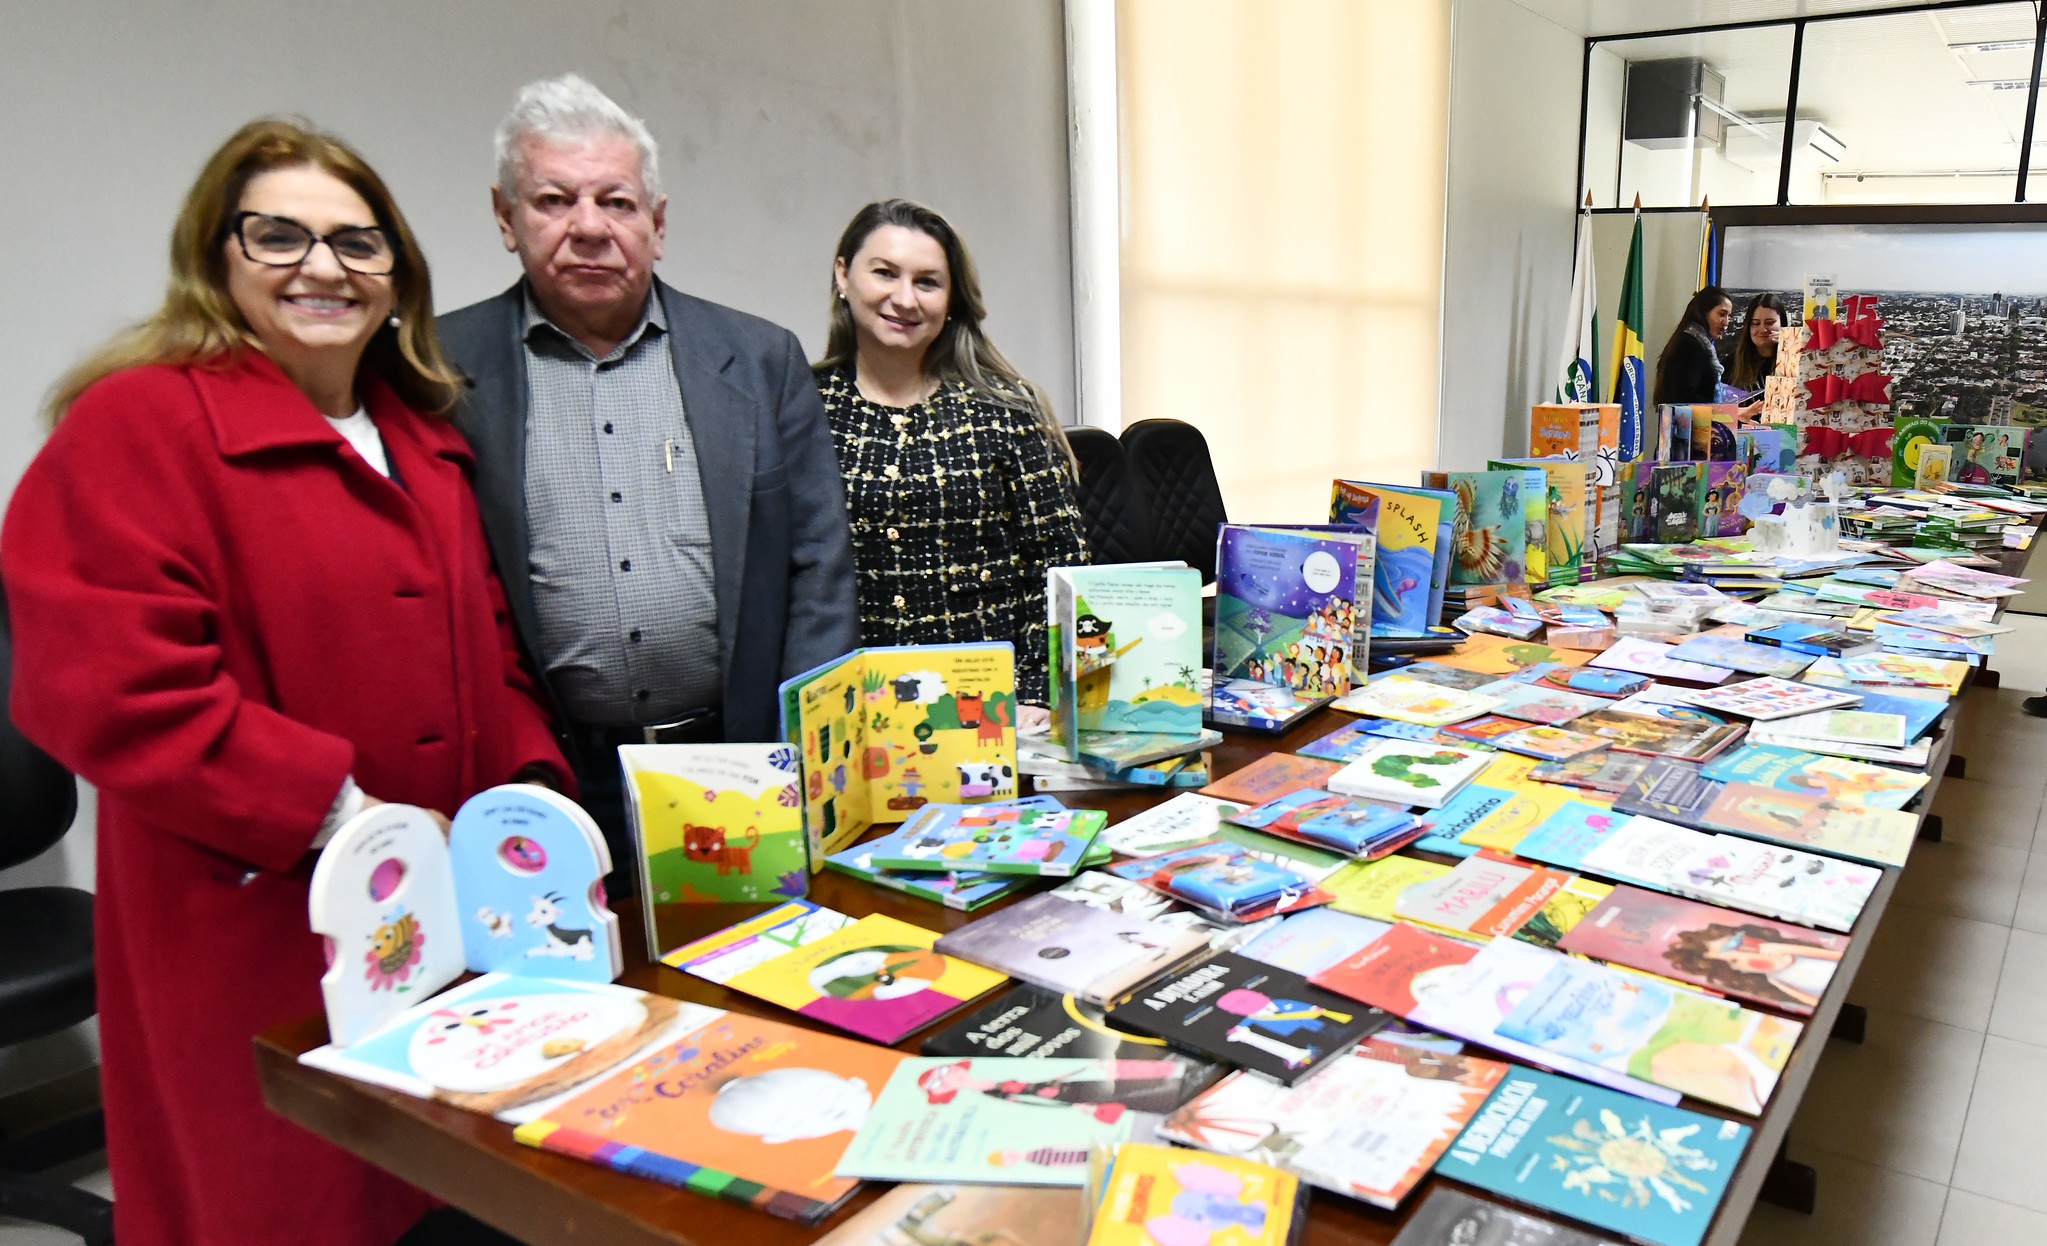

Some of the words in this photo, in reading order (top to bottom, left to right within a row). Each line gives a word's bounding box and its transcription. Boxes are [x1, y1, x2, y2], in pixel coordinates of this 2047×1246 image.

[1841, 294, 1879, 327] 15
[1386, 501, 1429, 544] SPLASH
[965, 1031, 987, 1045] A
[979, 1004, 1031, 1033] lenda
[1450, 1148, 1481, 1166] A
